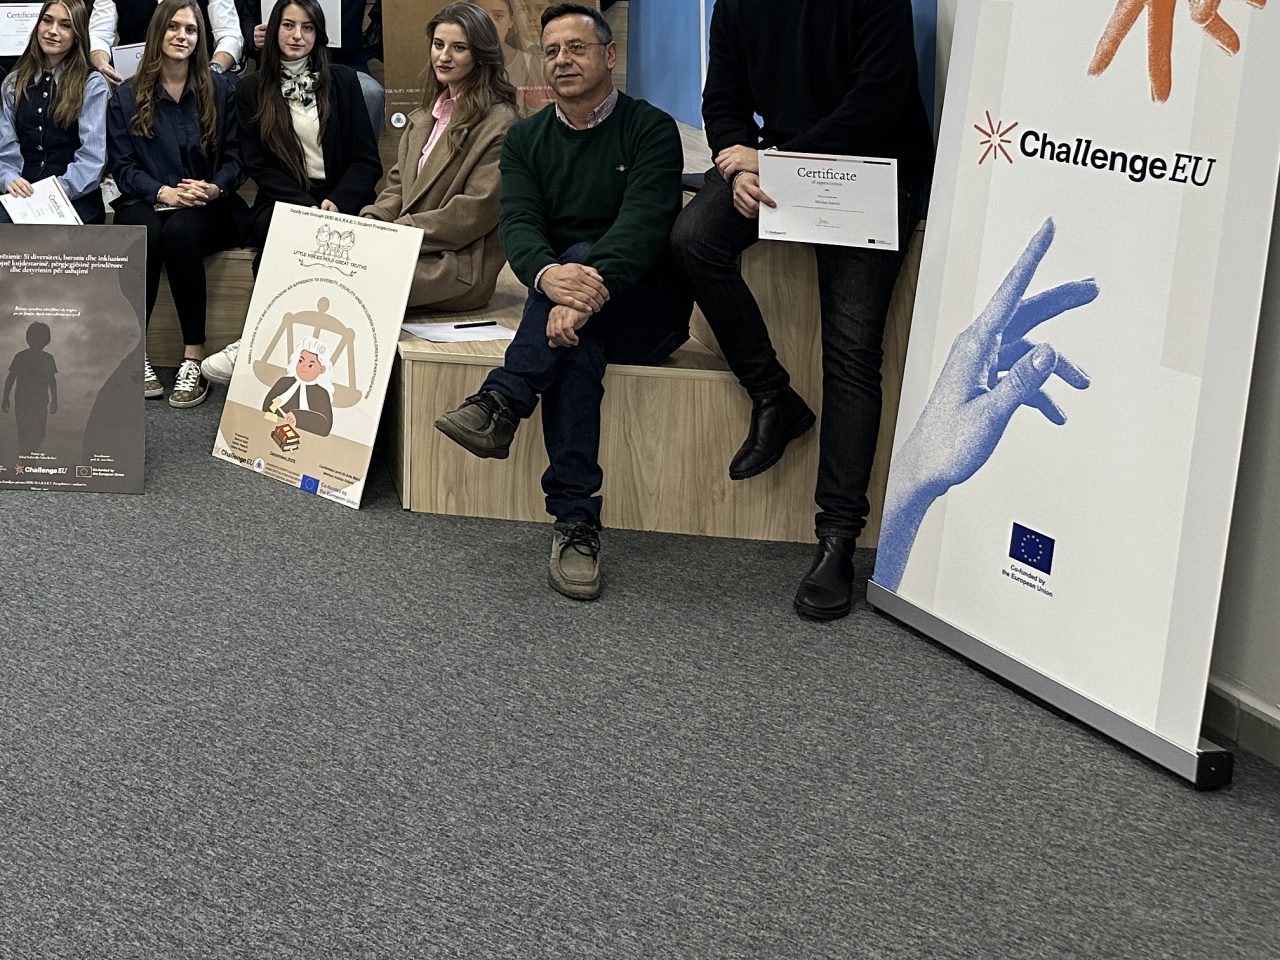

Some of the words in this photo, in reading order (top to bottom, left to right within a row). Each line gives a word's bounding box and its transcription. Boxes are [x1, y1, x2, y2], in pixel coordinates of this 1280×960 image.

[797, 167, 857, 181] Certificate
[85, 254, 97, 262] dhe
[1001, 569, 1010, 577] the
[1011, 573, 1036, 589] European
[1037, 586, 1053, 597] Union
[1011, 564, 1037, 581] Co-funded
[1038, 576, 1046, 586] by
